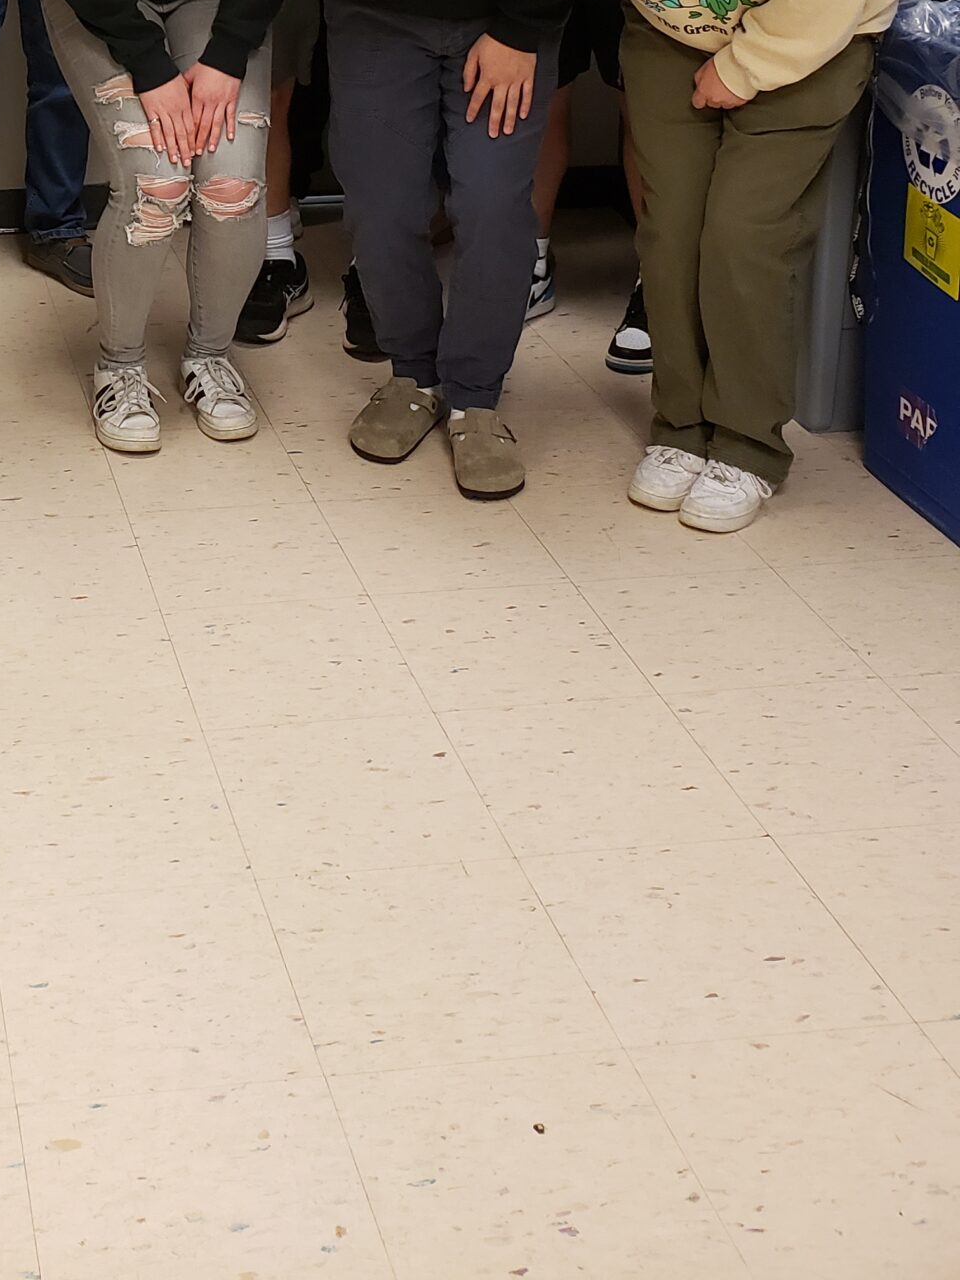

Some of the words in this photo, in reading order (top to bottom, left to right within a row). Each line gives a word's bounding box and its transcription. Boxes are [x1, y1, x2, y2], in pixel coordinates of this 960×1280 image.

[656, 15, 681, 33] The
[683, 23, 729, 36] Green
[907, 158, 957, 203] RECYCLE
